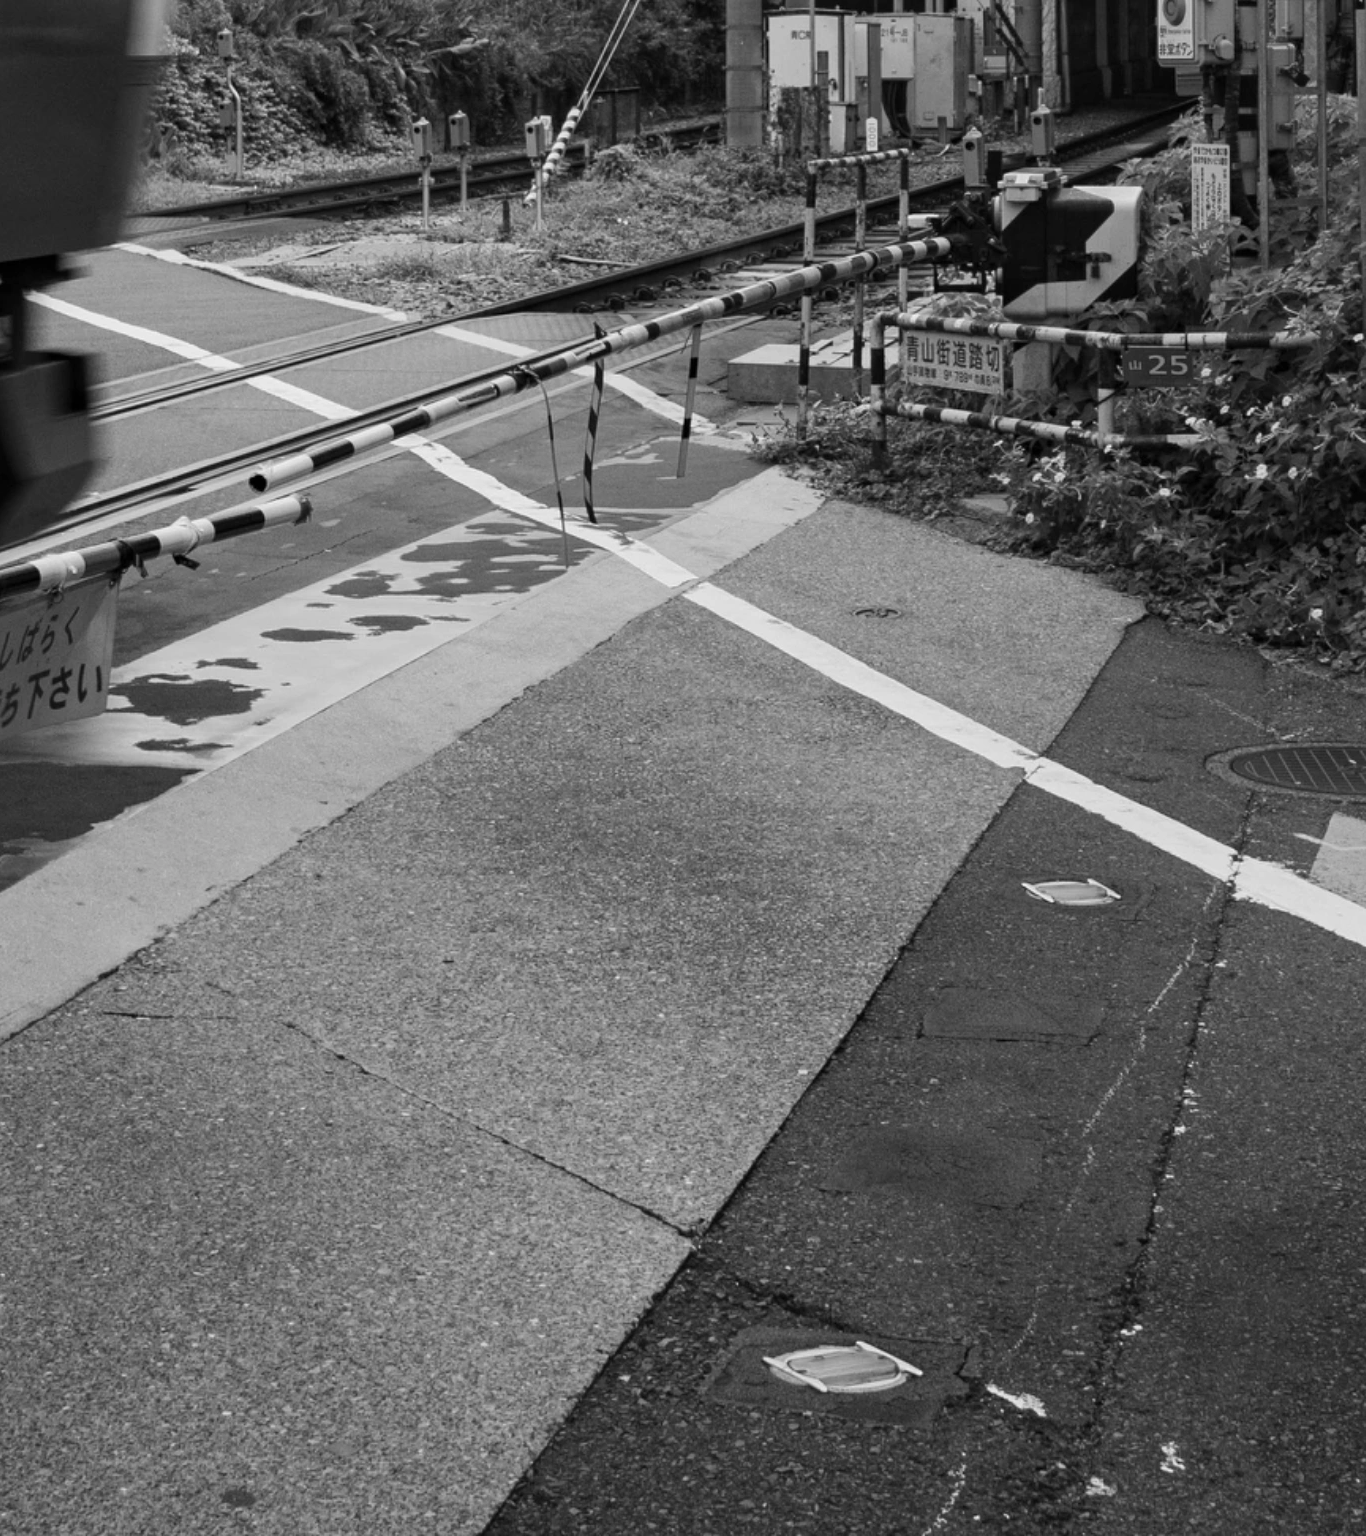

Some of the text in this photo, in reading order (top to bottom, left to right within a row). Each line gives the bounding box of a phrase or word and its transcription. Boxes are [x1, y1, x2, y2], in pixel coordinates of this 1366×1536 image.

[907, 336, 999, 372] 青山街道踏切
[1128, 355, 1188, 376] 山 25
